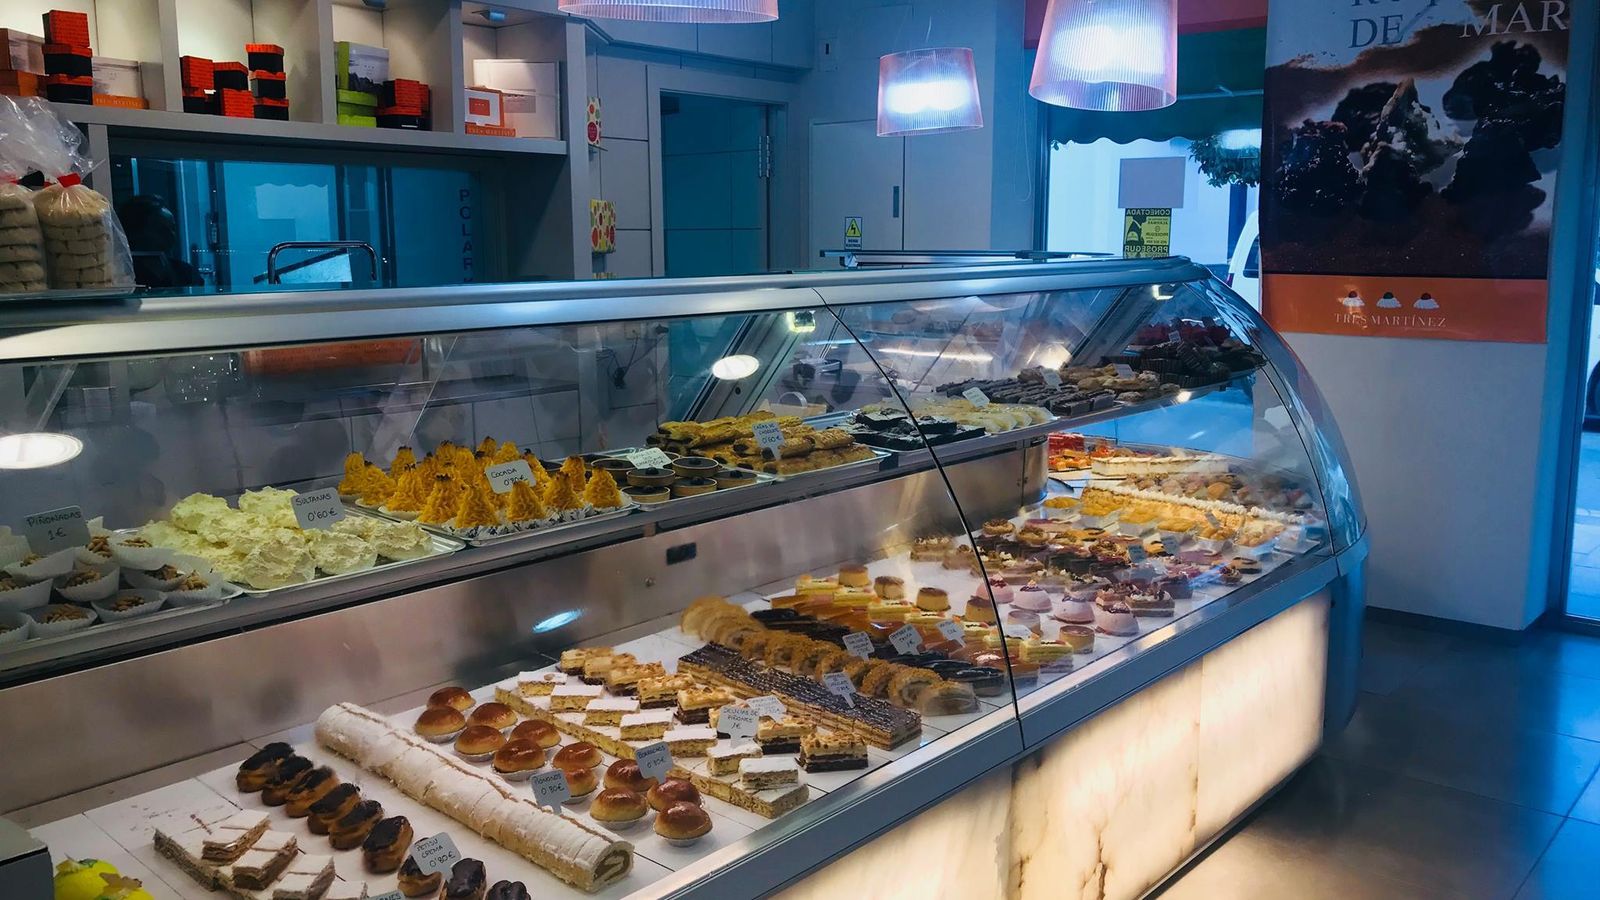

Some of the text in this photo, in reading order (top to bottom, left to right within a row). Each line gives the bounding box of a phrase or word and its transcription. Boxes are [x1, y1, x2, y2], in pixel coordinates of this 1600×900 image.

[1348, 0, 1568, 48] DE MAR
[459, 188, 474, 283] POLAR
[1334, 312, 1447, 328] TRES MARTÍNEZ
[491, 468, 517, 478] COCADA
[295, 493, 332, 506] SULTANAS
